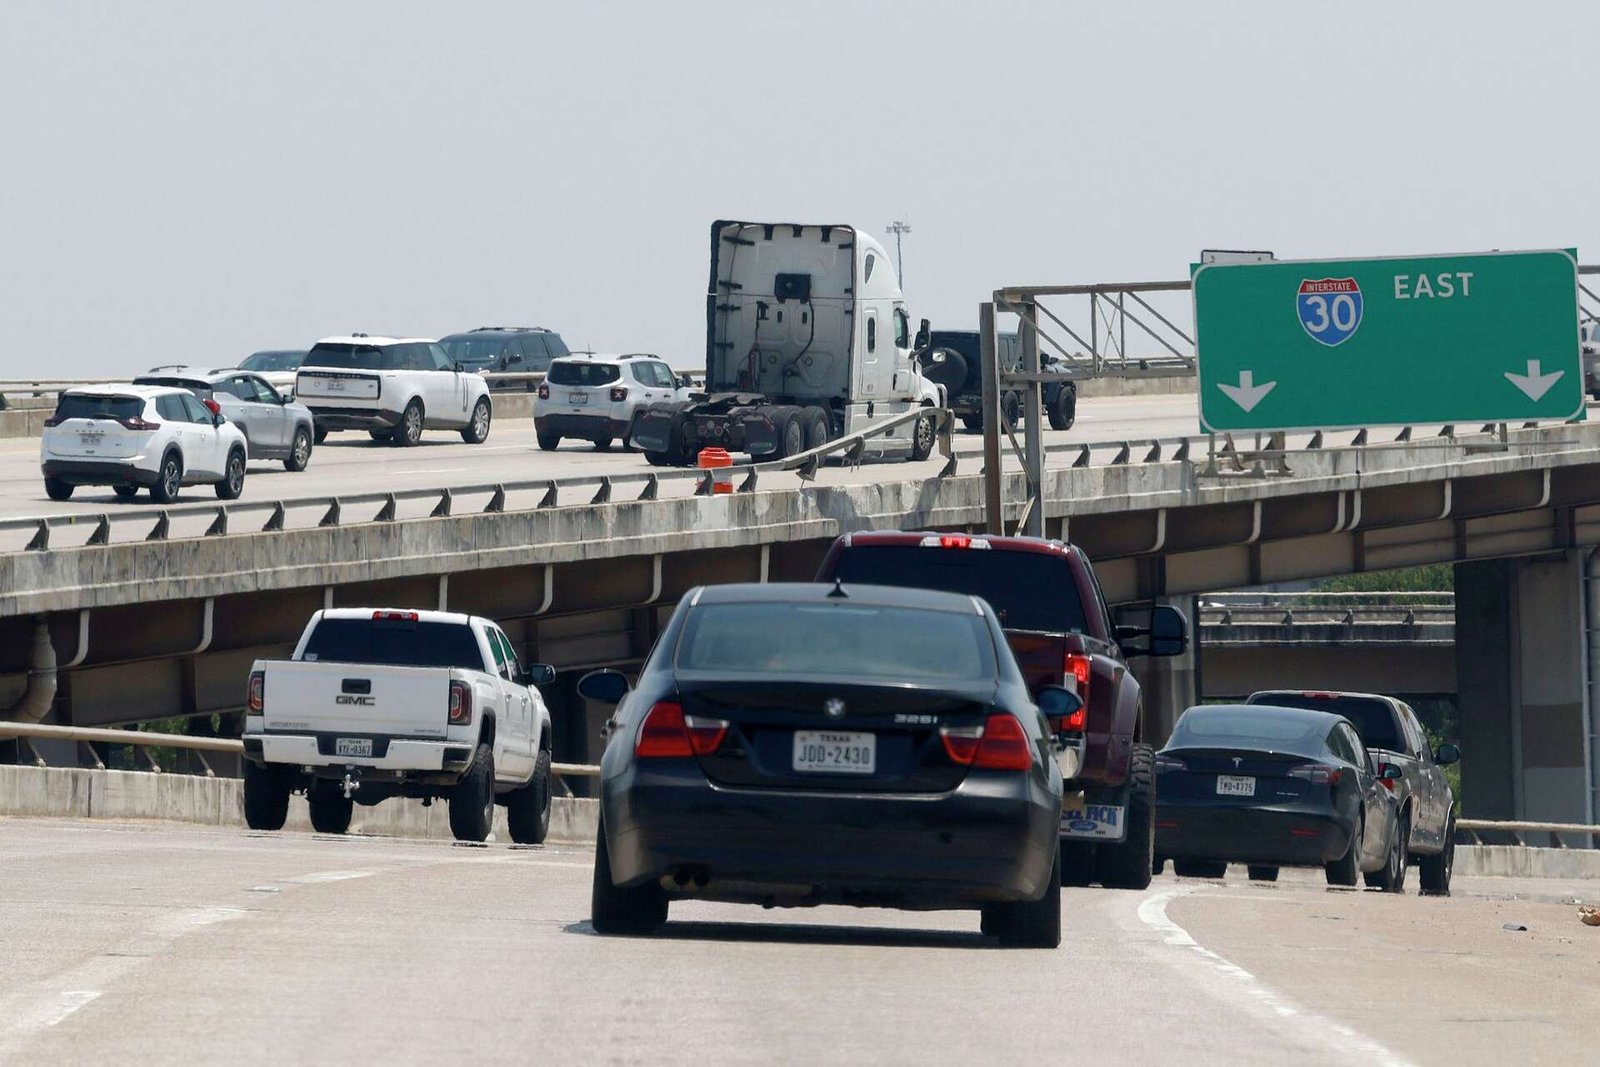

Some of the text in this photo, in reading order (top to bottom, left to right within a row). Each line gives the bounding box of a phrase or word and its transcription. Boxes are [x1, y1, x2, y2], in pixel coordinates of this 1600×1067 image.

[1305, 282, 1351, 293] INTERSTATE
[1394, 272, 1474, 299] EAST
[1305, 294, 1357, 333] 30
[336, 695, 376, 706] GMC
[819, 733, 851, 743] TEXAS
